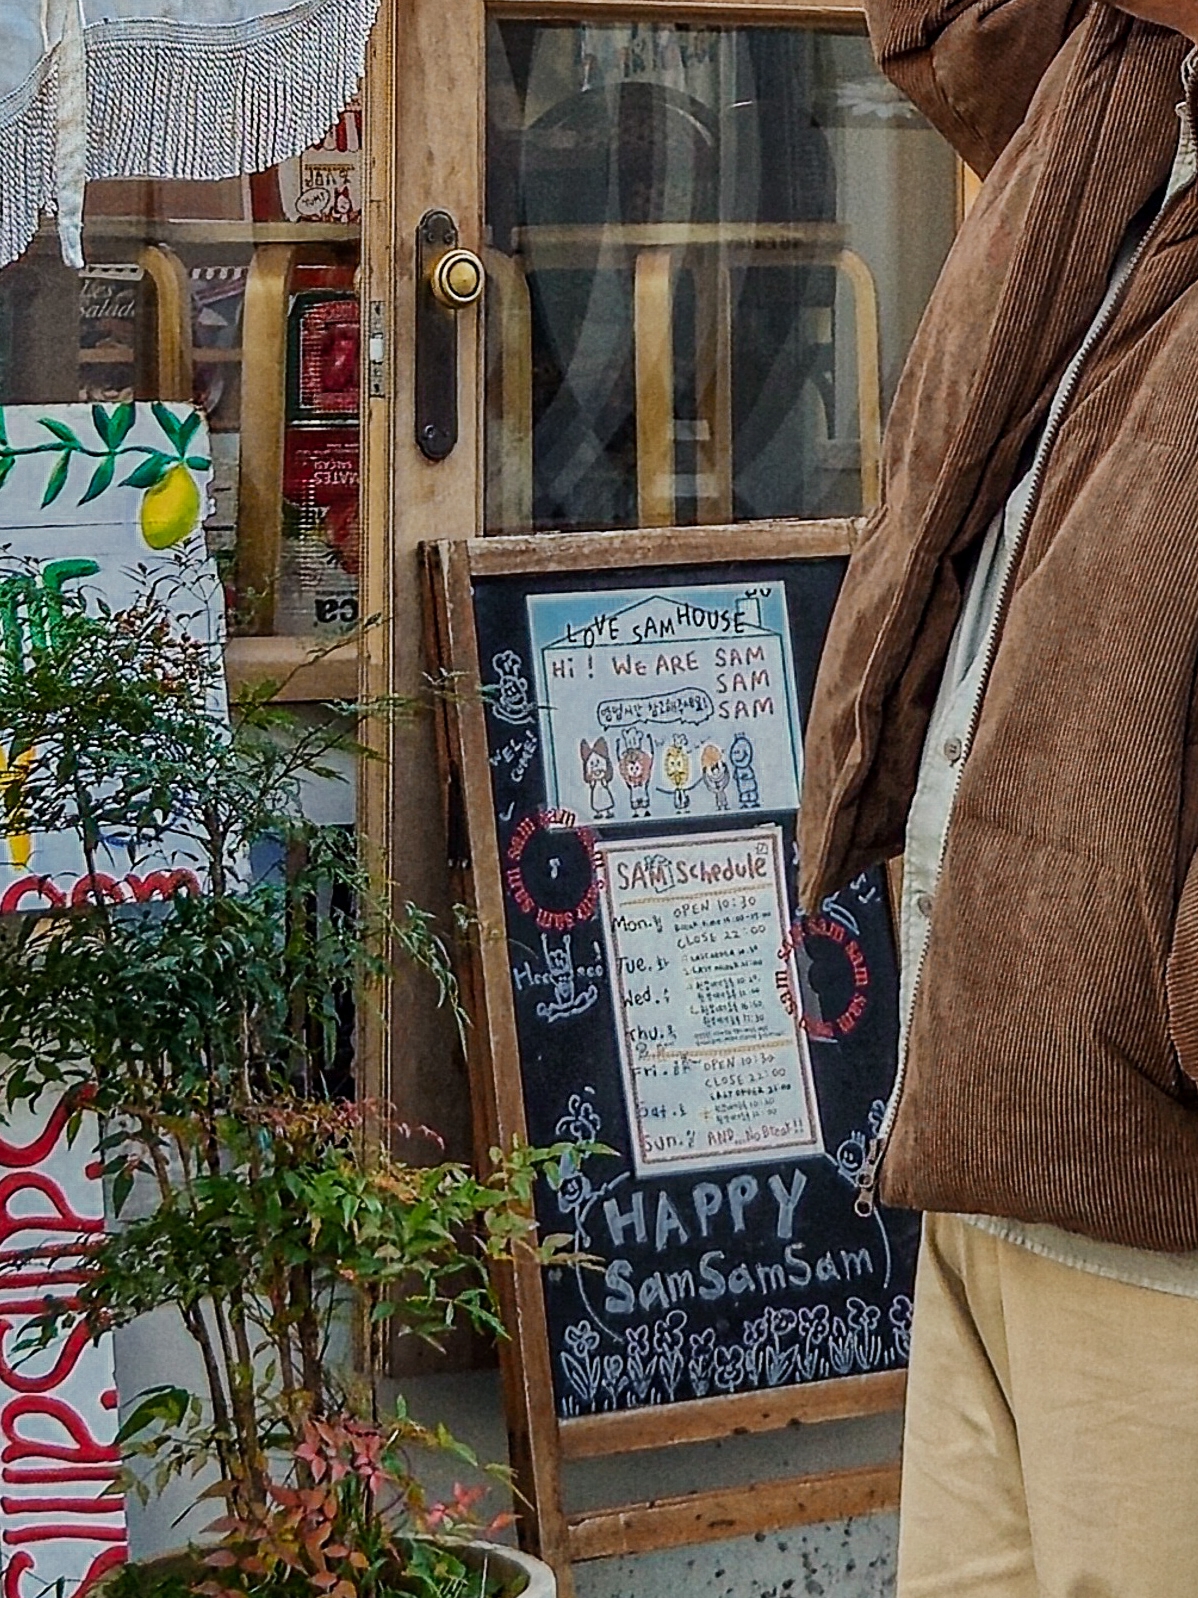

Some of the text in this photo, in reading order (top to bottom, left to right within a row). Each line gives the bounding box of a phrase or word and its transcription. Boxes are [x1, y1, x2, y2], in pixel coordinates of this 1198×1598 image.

[567, 603, 746, 648] LOVE SAM HOUSE
[656, 650, 699, 676] ARE
[714, 645, 765, 668] SAM
[716, 669, 770, 694] SAM
[718, 697, 774, 720] SAM
[617, 852, 767, 891] SAM Schedule
[673, 896, 756, 918] OPEN 10:30
[677, 924, 766, 949] CLOSE 22:00
[704, 1056, 735, 1071] OPEN
[705, 1074, 743, 1088] CLOSE
[602, 1168, 808, 1252] HAPPY
